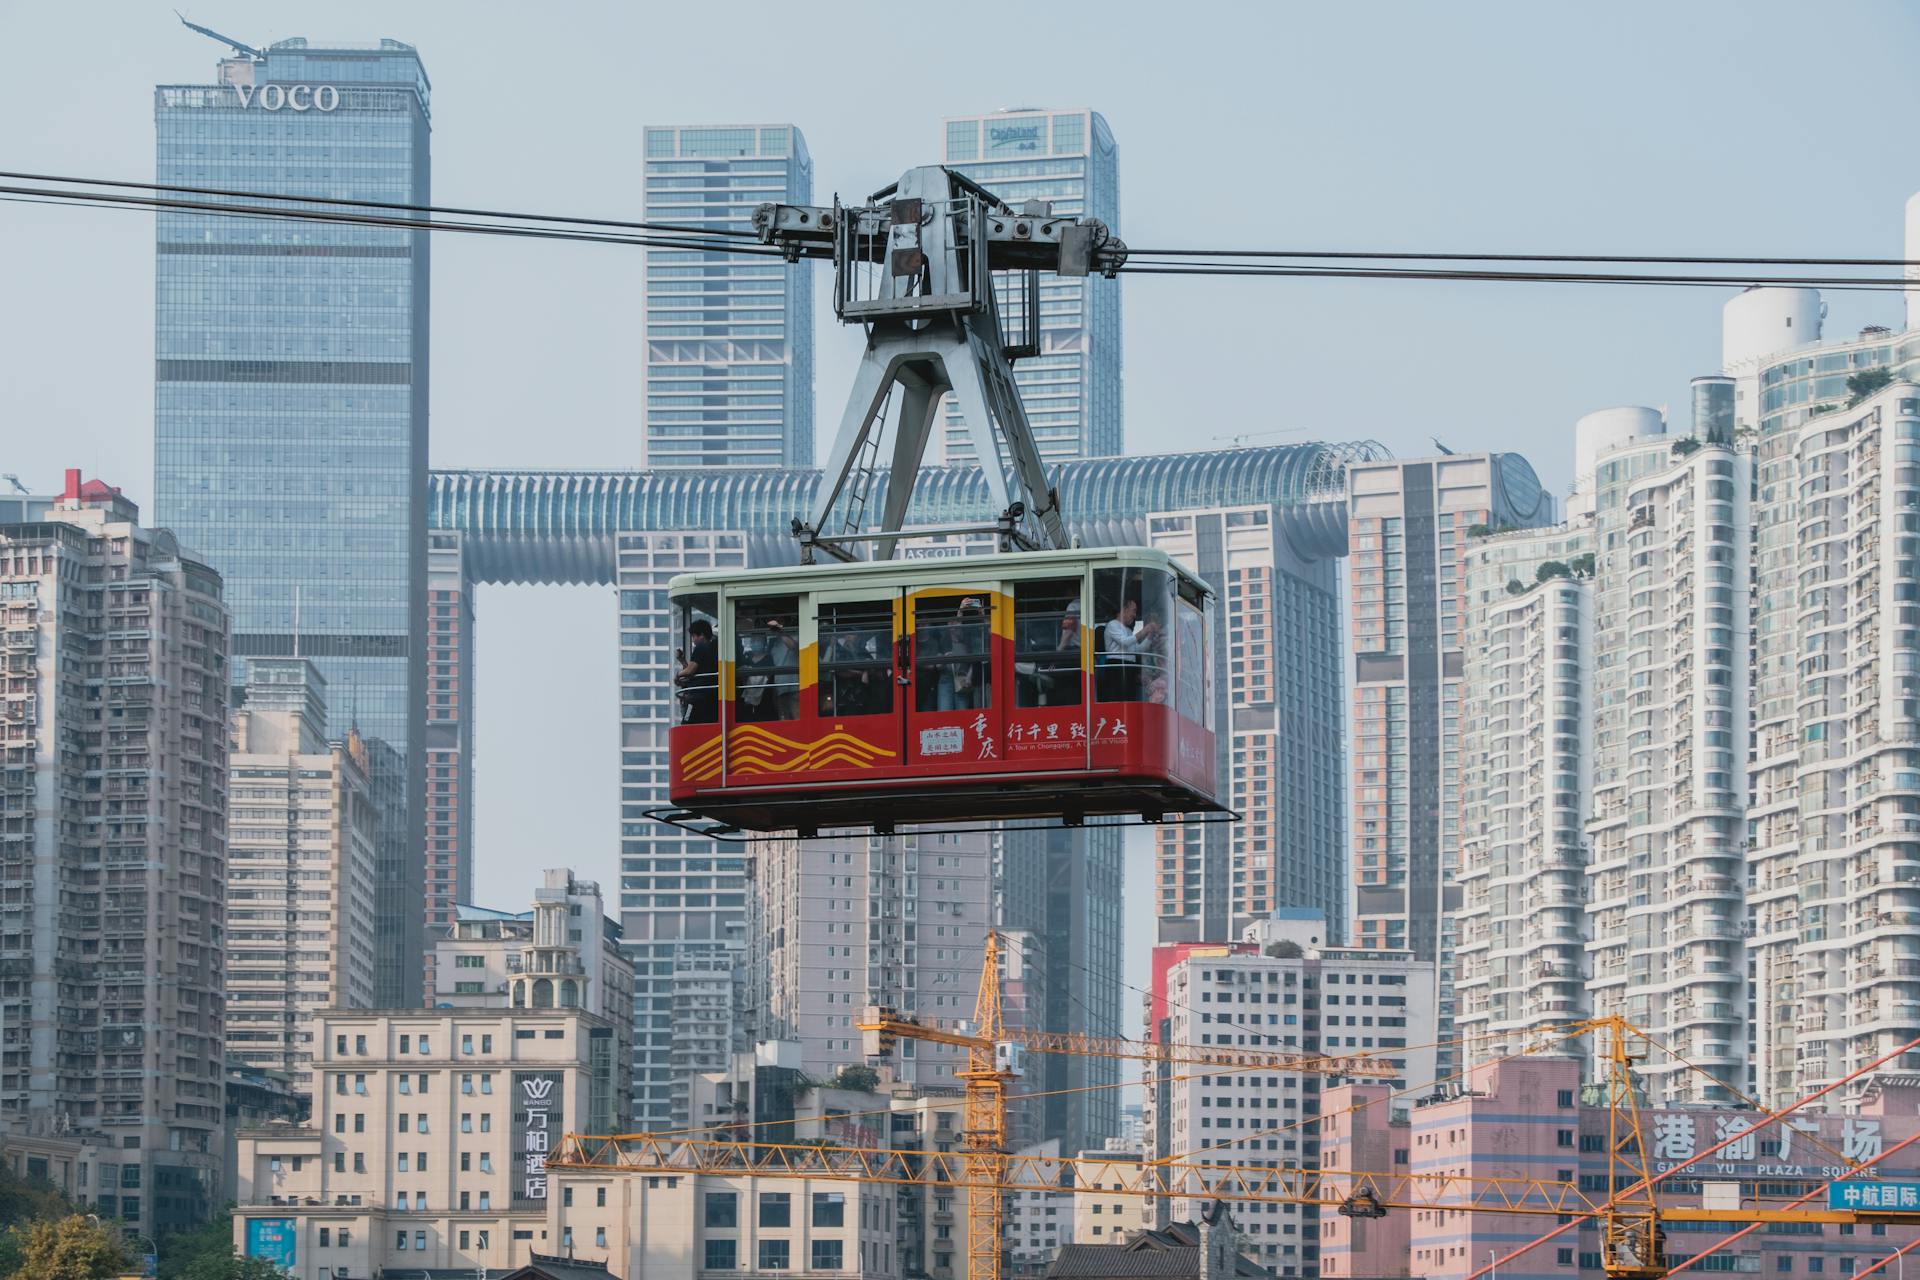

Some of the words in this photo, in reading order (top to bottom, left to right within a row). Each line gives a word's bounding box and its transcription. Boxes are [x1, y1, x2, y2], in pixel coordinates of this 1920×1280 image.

[906, 549, 960, 559] ASCOTT
[1007, 721, 1059, 742] 行千里
[1653, 1114, 1882, 1162] 港渝广场
[525, 1108, 549, 1199] 万柏酒店
[1716, 1163, 1736, 1174] YU
[1757, 1164, 1804, 1176] PLAZA
[1843, 1184, 1918, 1207] 中航国际
